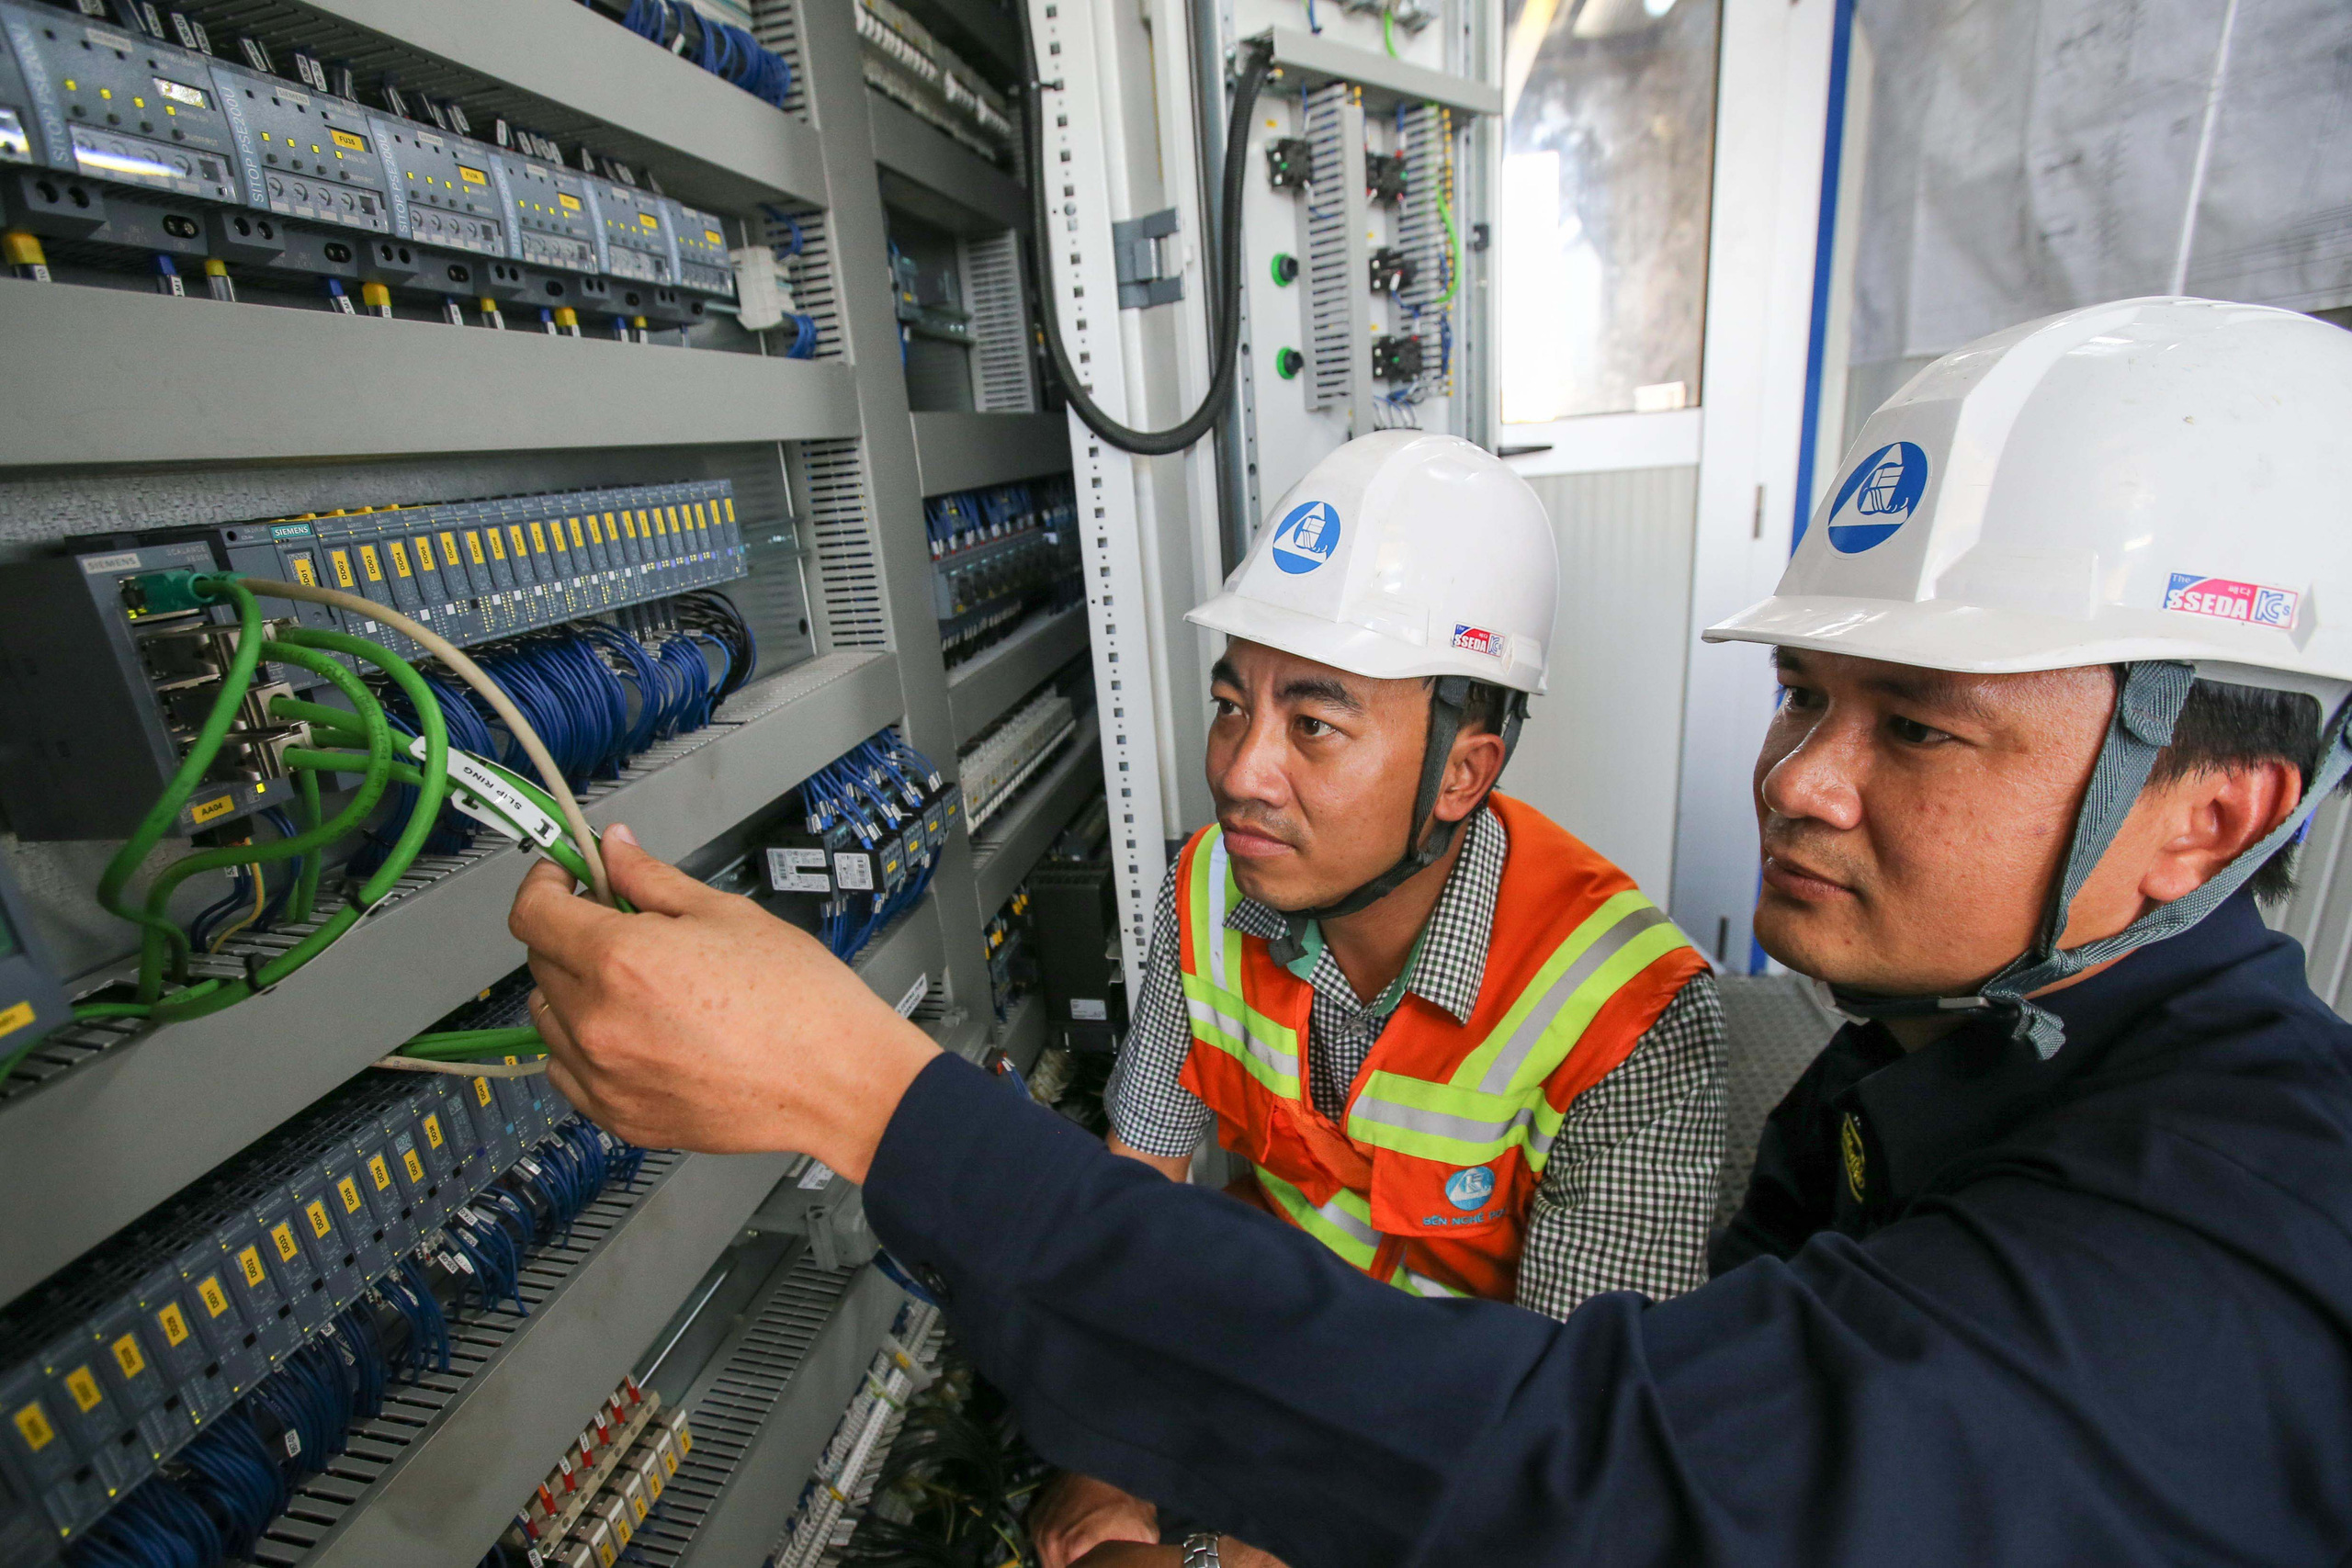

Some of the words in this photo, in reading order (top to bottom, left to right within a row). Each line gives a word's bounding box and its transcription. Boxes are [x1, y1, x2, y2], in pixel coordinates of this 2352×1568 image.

[220, 87, 253, 156] PSE200U
[338, 135, 356, 145] FU35
[377, 133, 401, 191] PSE200U
[244, 158, 265, 203] SITOP
[392, 196, 408, 233] SITOP
[275, 526, 309, 536] SIEMENS
[167, 545, 206, 557] SCALANCE
[420, 546, 430, 564] DD05
[445, 541, 454, 558] DD06
[470, 540, 480, 558] DD07
[88, 558, 137, 570] SIEMENS
[338, 560, 347, 581] DD02
[366, 555, 376, 574] DD03
[395, 552, 405, 570] DD04
[2172, 574, 2191, 583] The
[2166, 588, 2248, 620] SSEDA
[1453, 634, 1487, 653] SSEDA
[463, 766, 494, 789] RING
[201, 802, 223, 816] AA04
[496, 790, 523, 810] SLIP
[477, 1083, 488, 1100] DD42
[428, 1125, 438, 1142] DD38
[374, 1165, 385, 1183] DD36
[408, 1159, 419, 1176] DD37
[344, 1187, 356, 1206] DD35
[312, 1211, 325, 1231] DD34
[278, 1235, 290, 1255] DD33
[245, 1258, 258, 1279] DD32
[441, 1254, 457, 1273] 535-08
[206, 1288, 220, 1310] DD31
[287, 1432, 300, 1454] 667-03
